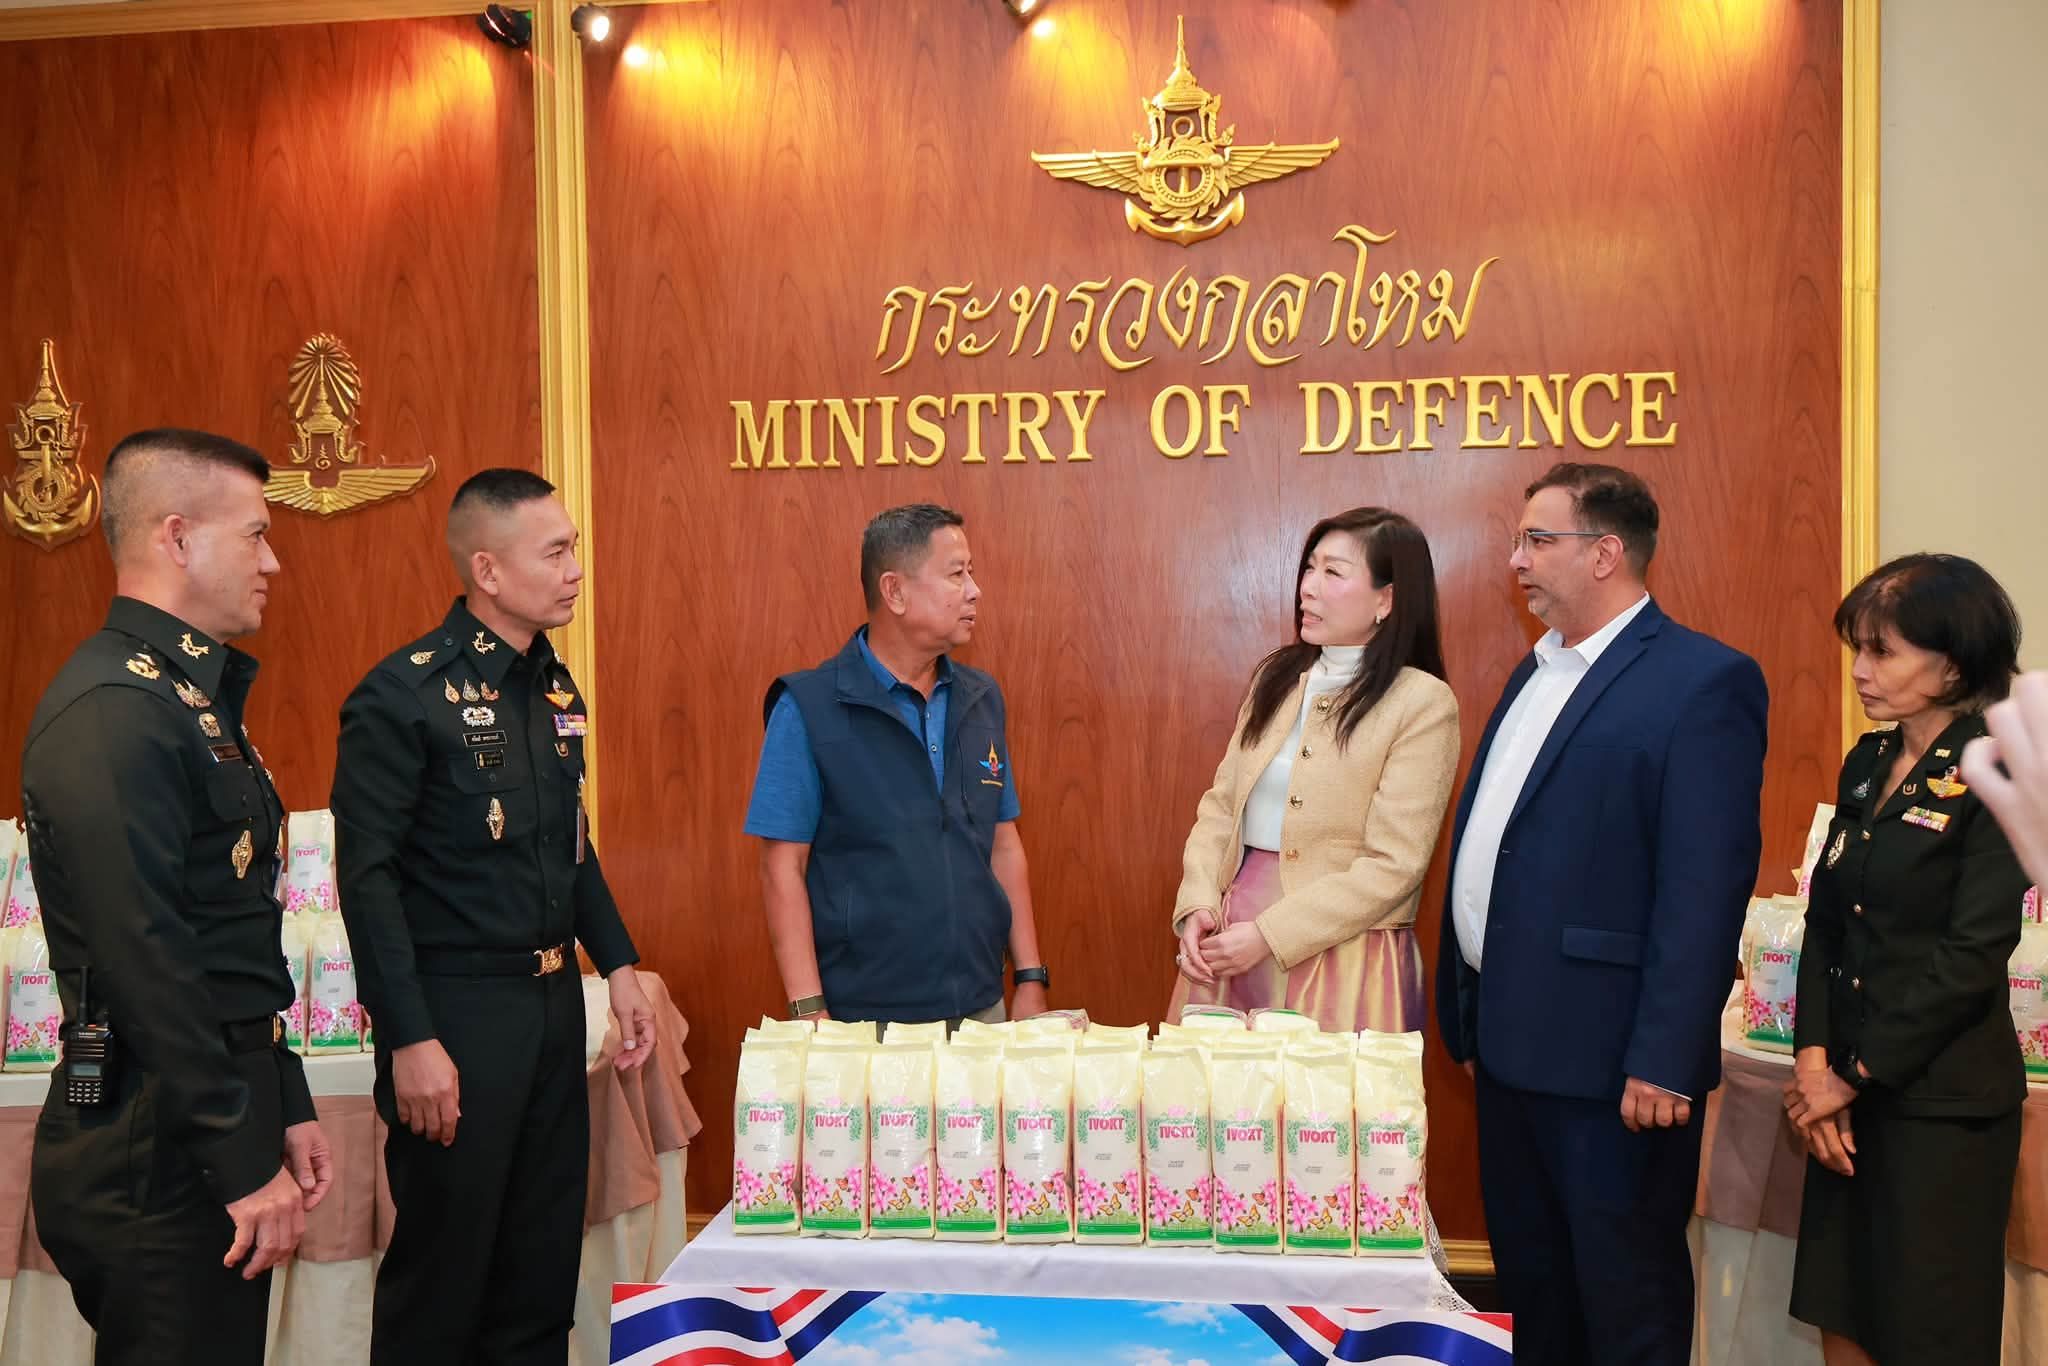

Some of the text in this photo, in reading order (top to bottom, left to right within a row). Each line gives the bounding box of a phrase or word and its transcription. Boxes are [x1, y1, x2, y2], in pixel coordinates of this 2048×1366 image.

[875, 225, 1500, 375] กระทรวงกลาโหม
[729, 371, 1678, 471] MINISTRY OF DEFENCE
